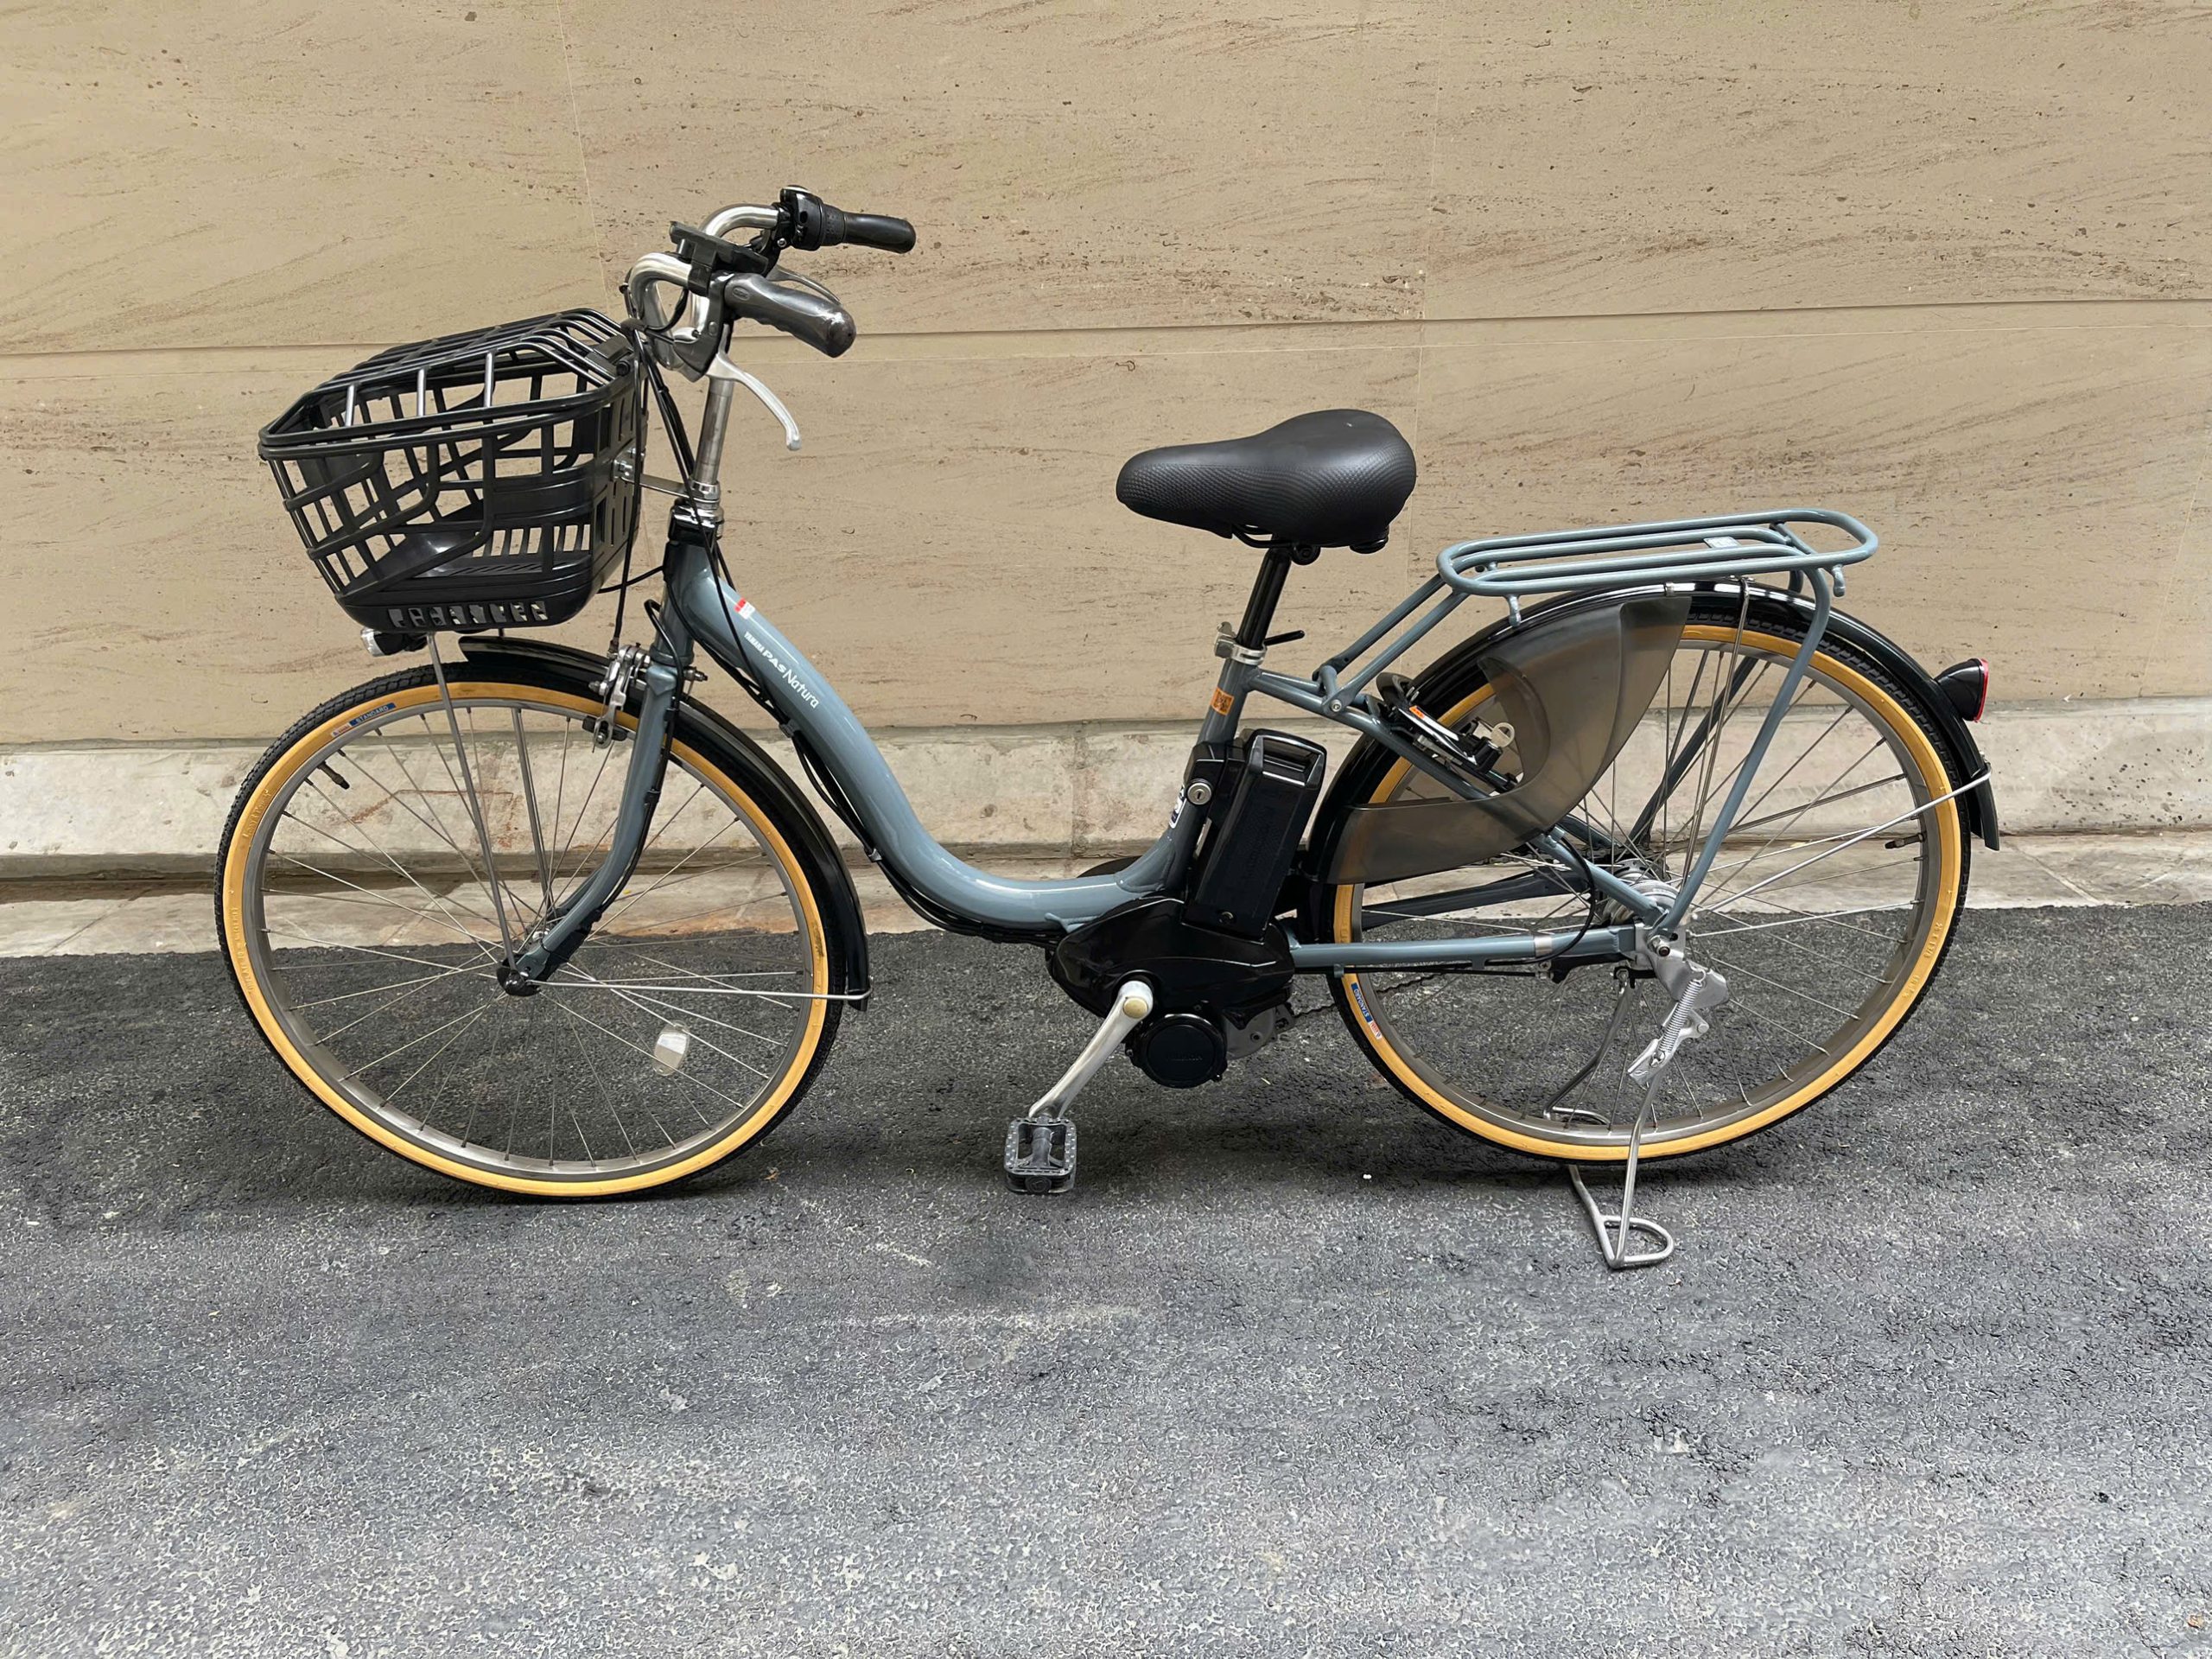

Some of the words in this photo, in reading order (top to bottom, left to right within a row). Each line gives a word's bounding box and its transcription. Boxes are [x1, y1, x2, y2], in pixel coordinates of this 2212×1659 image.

[762, 650, 787, 673] PAS
[782, 669, 819, 709] Natura
[355, 705, 389, 724] STANDARD
[1353, 988, 1370, 1018] STANDARD
